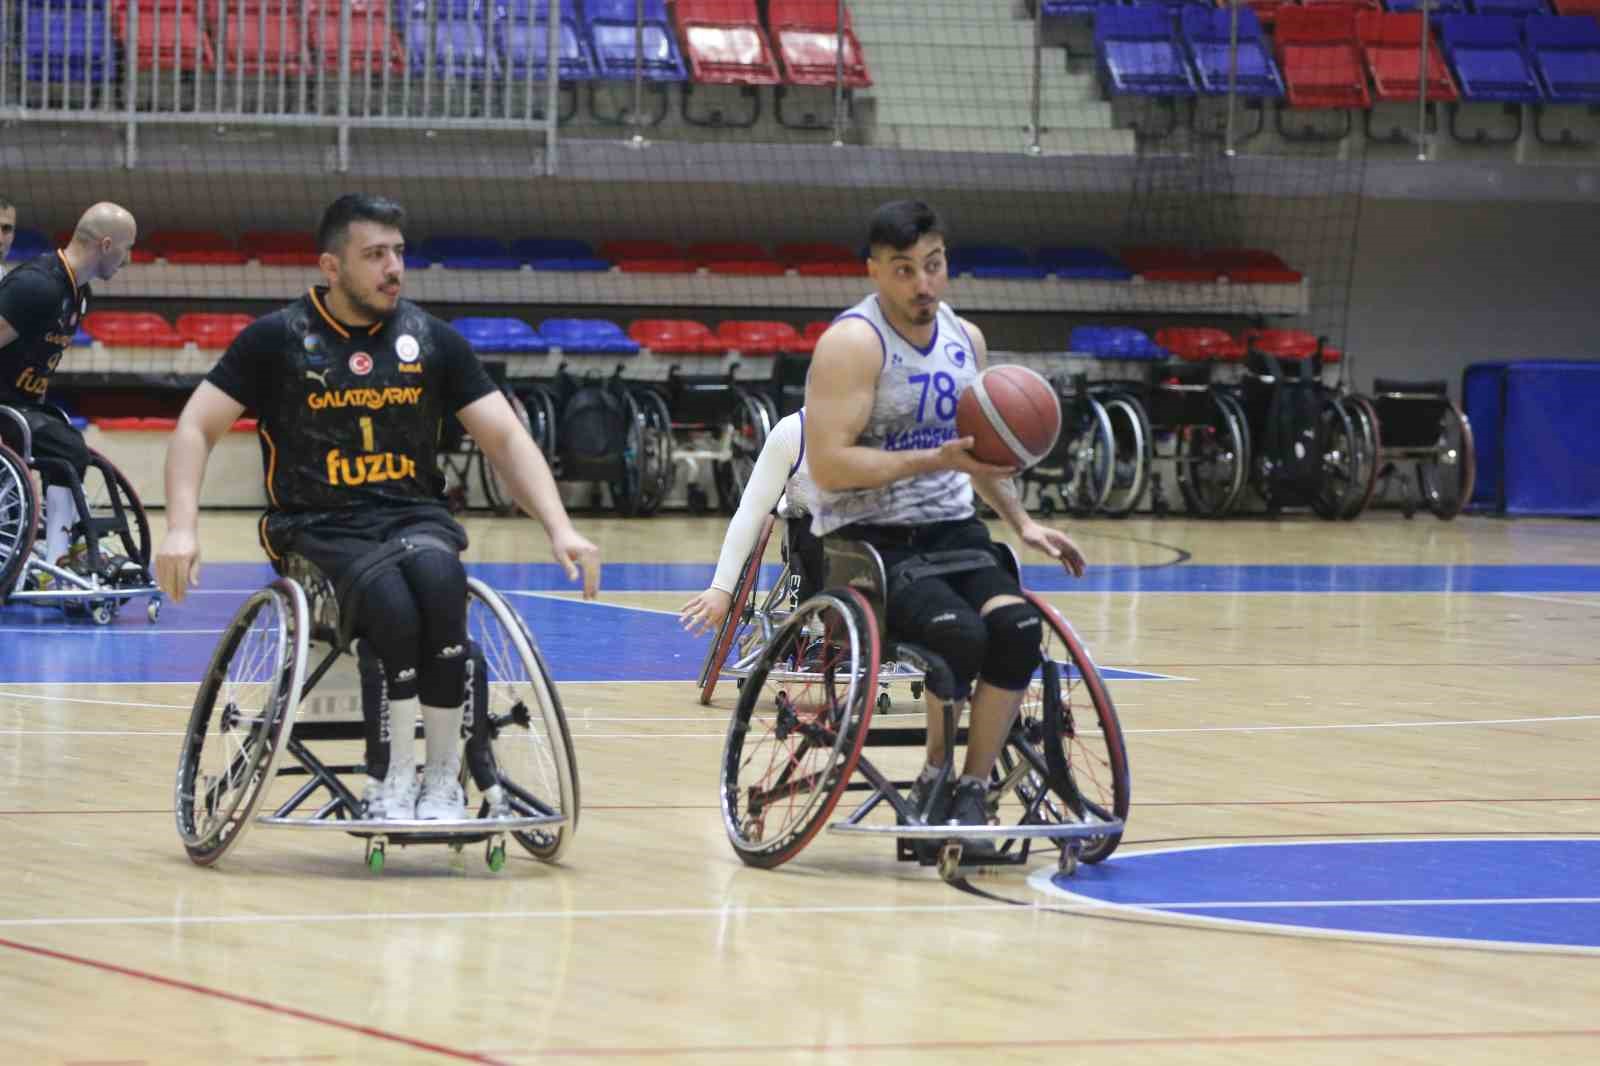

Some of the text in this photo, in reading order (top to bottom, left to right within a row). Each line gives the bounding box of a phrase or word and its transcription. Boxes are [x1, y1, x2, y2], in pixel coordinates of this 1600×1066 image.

[307, 386, 423, 410] GALATASARAY
[908, 371, 956, 424] 78
[359, 416, 375, 452] 1
